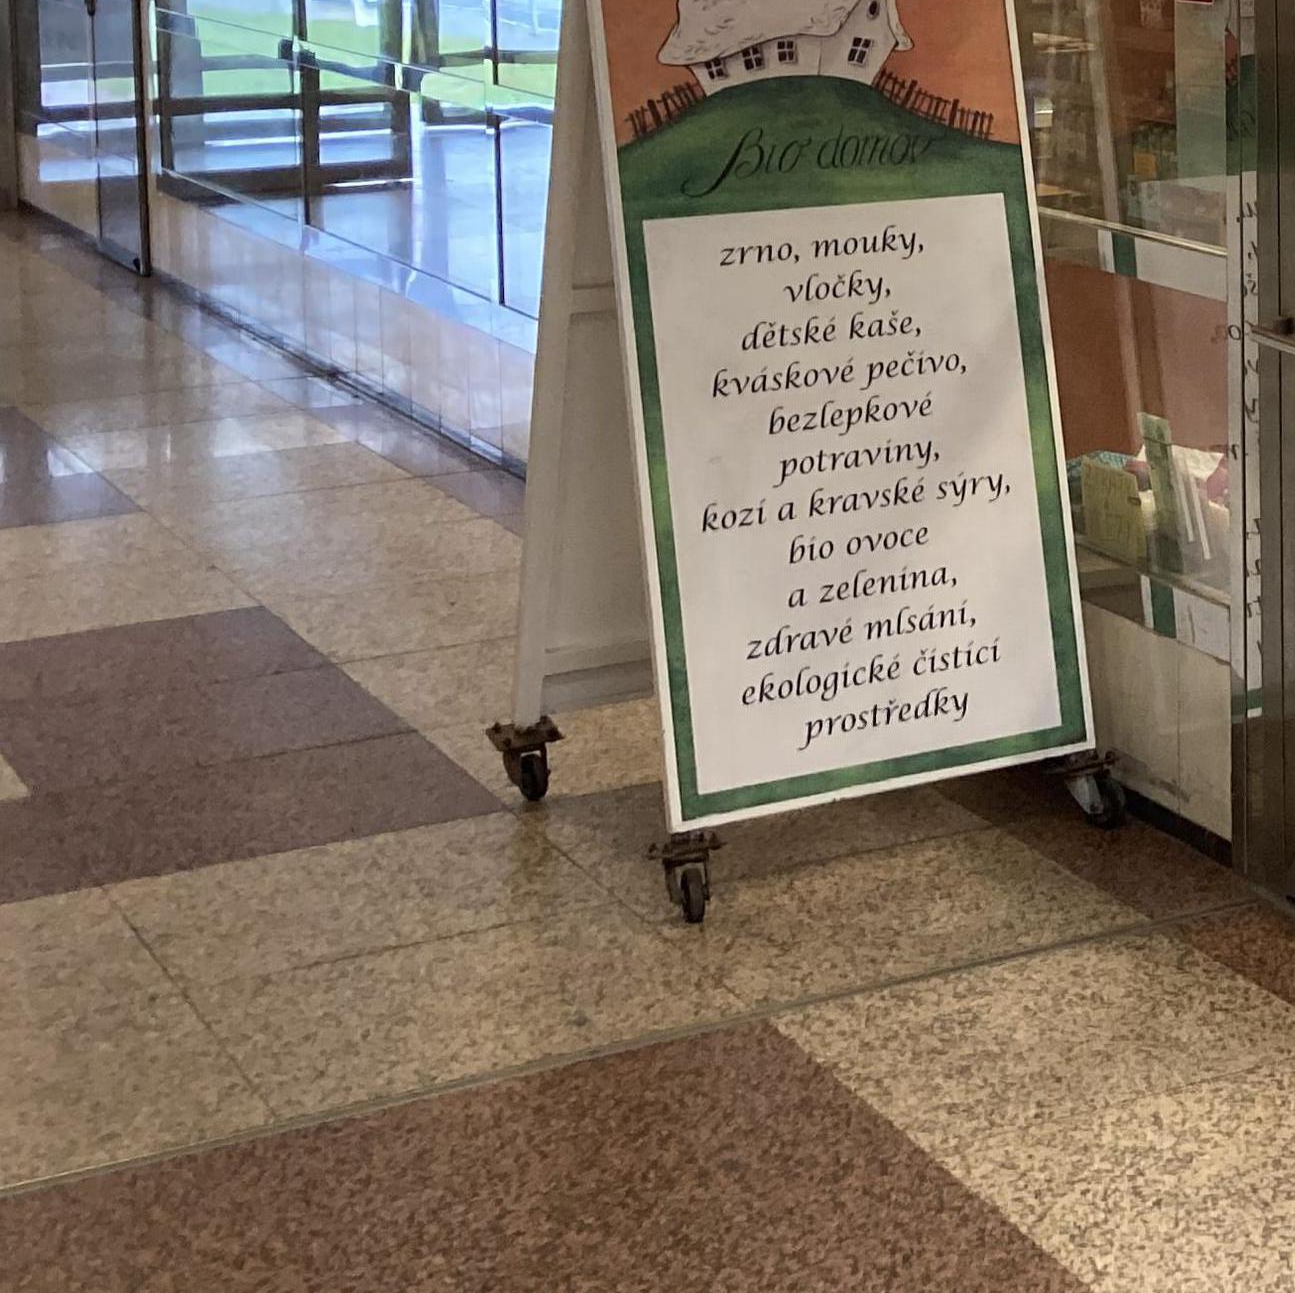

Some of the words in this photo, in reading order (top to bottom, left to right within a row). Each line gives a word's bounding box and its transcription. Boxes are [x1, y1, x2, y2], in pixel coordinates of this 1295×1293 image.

[719, 241, 801, 268] zrno,
[811, 224, 925, 261] mouky,
[783, 268, 892, 304] vločky,
[741, 317, 838, 353] dětské
[848, 308, 922, 340] kaše,
[712, 356, 855, 399] kváskové
[860, 349, 968, 391] pečivo,
[768, 391, 934, 437] bezlepkové
[772, 435, 941, 489] potraviny,
[701, 497, 767, 534] kozí
[777, 501, 797, 522] a
[807, 475, 926, 520] kravské
[935, 470, 1012, 504] sýry,
[788, 533, 836, 565] bio
[845, 524, 930, 557] ovoce
[787, 586, 807, 610] a
[818, 563, 959, 606] zelenina,
[746, 617, 854, 662] zdravé
[863, 599, 978, 641] mlsání,
[741, 653, 901, 707] ekologické
[797, 686, 970, 751] prostředky
